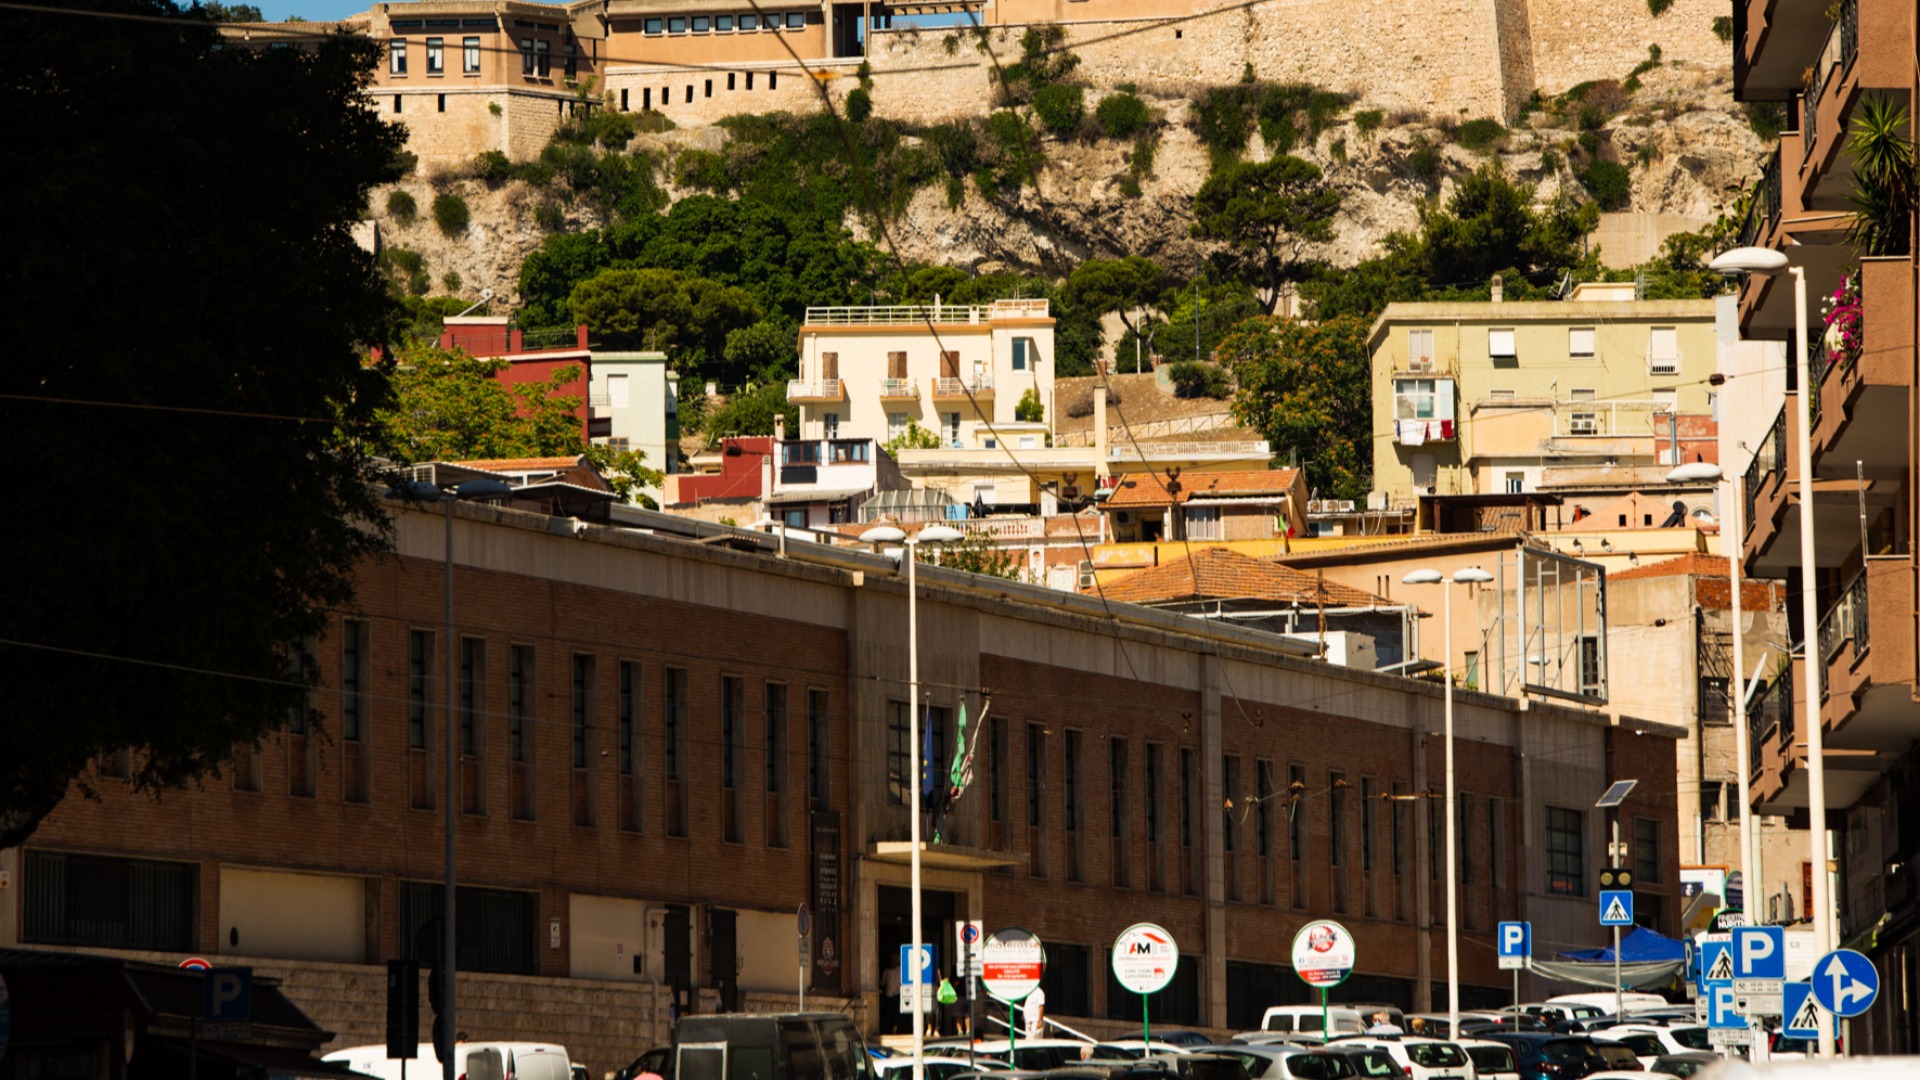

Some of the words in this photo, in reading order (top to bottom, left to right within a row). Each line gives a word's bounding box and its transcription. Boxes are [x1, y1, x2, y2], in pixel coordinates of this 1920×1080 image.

[1505, 925, 1524, 953] P
[1742, 932, 1774, 974] P
[908, 949, 931, 981] P
[1685, 942, 1693, 978] P
[212, 974, 242, 1016] P
